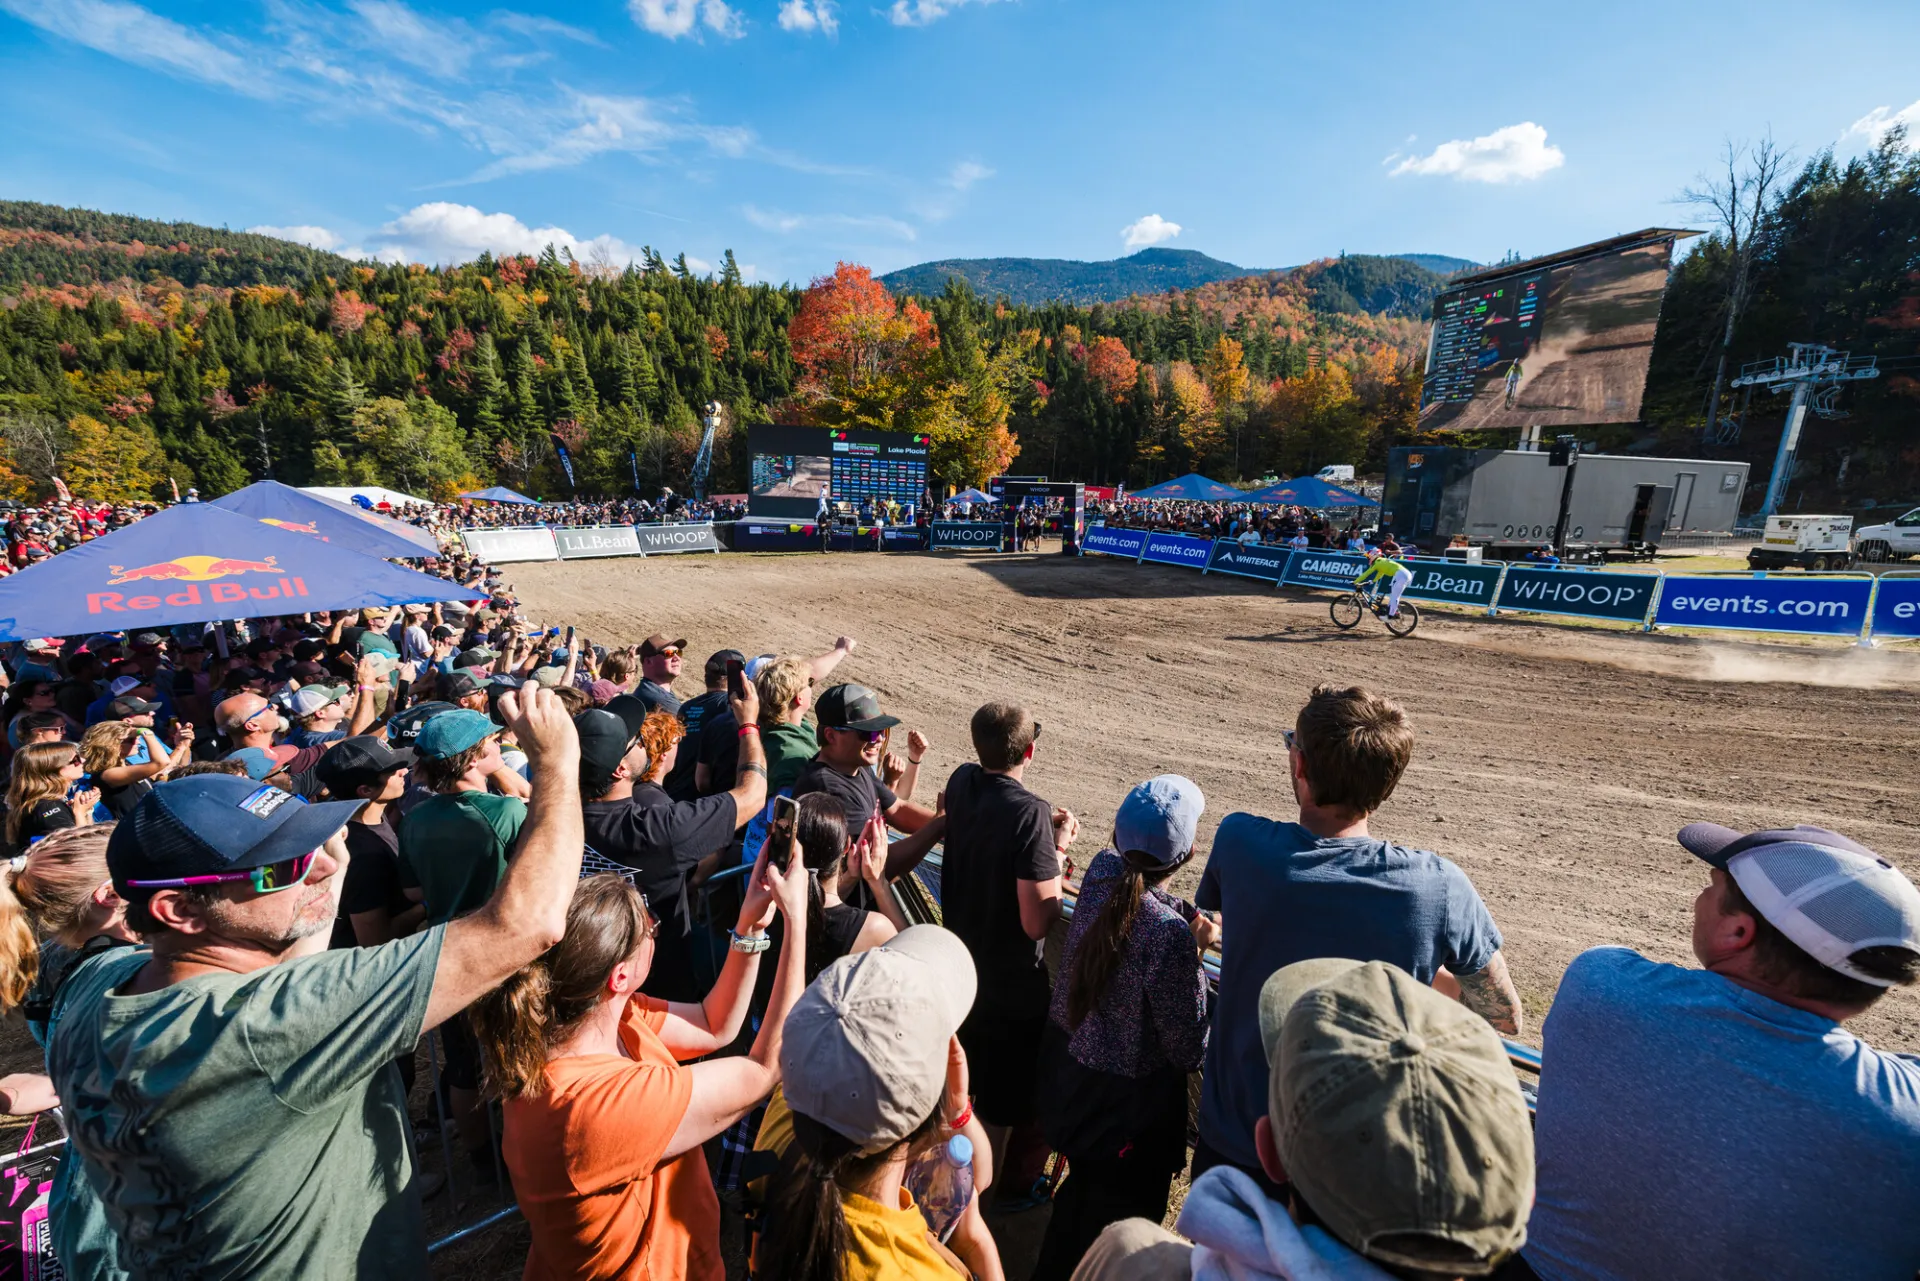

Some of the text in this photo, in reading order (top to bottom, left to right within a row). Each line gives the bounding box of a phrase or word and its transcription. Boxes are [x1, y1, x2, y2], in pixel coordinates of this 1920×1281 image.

[905, 447, 926, 455] Placid
[645, 531, 706, 546] WHOOP
[937, 529, 994, 541] WHOOP
[1088, 534, 1140, 549] events.com
[564, 535, 631, 551] L.L.Bean
[1150, 543, 1206, 558] events.com
[1236, 555, 1280, 568] WHITEFACE
[86, 577, 309, 614] Red Bull
[1514, 580, 1635, 606] WHOOP
[1672, 595, 1849, 618] events.com
[46, 807, 61, 816] UCI
